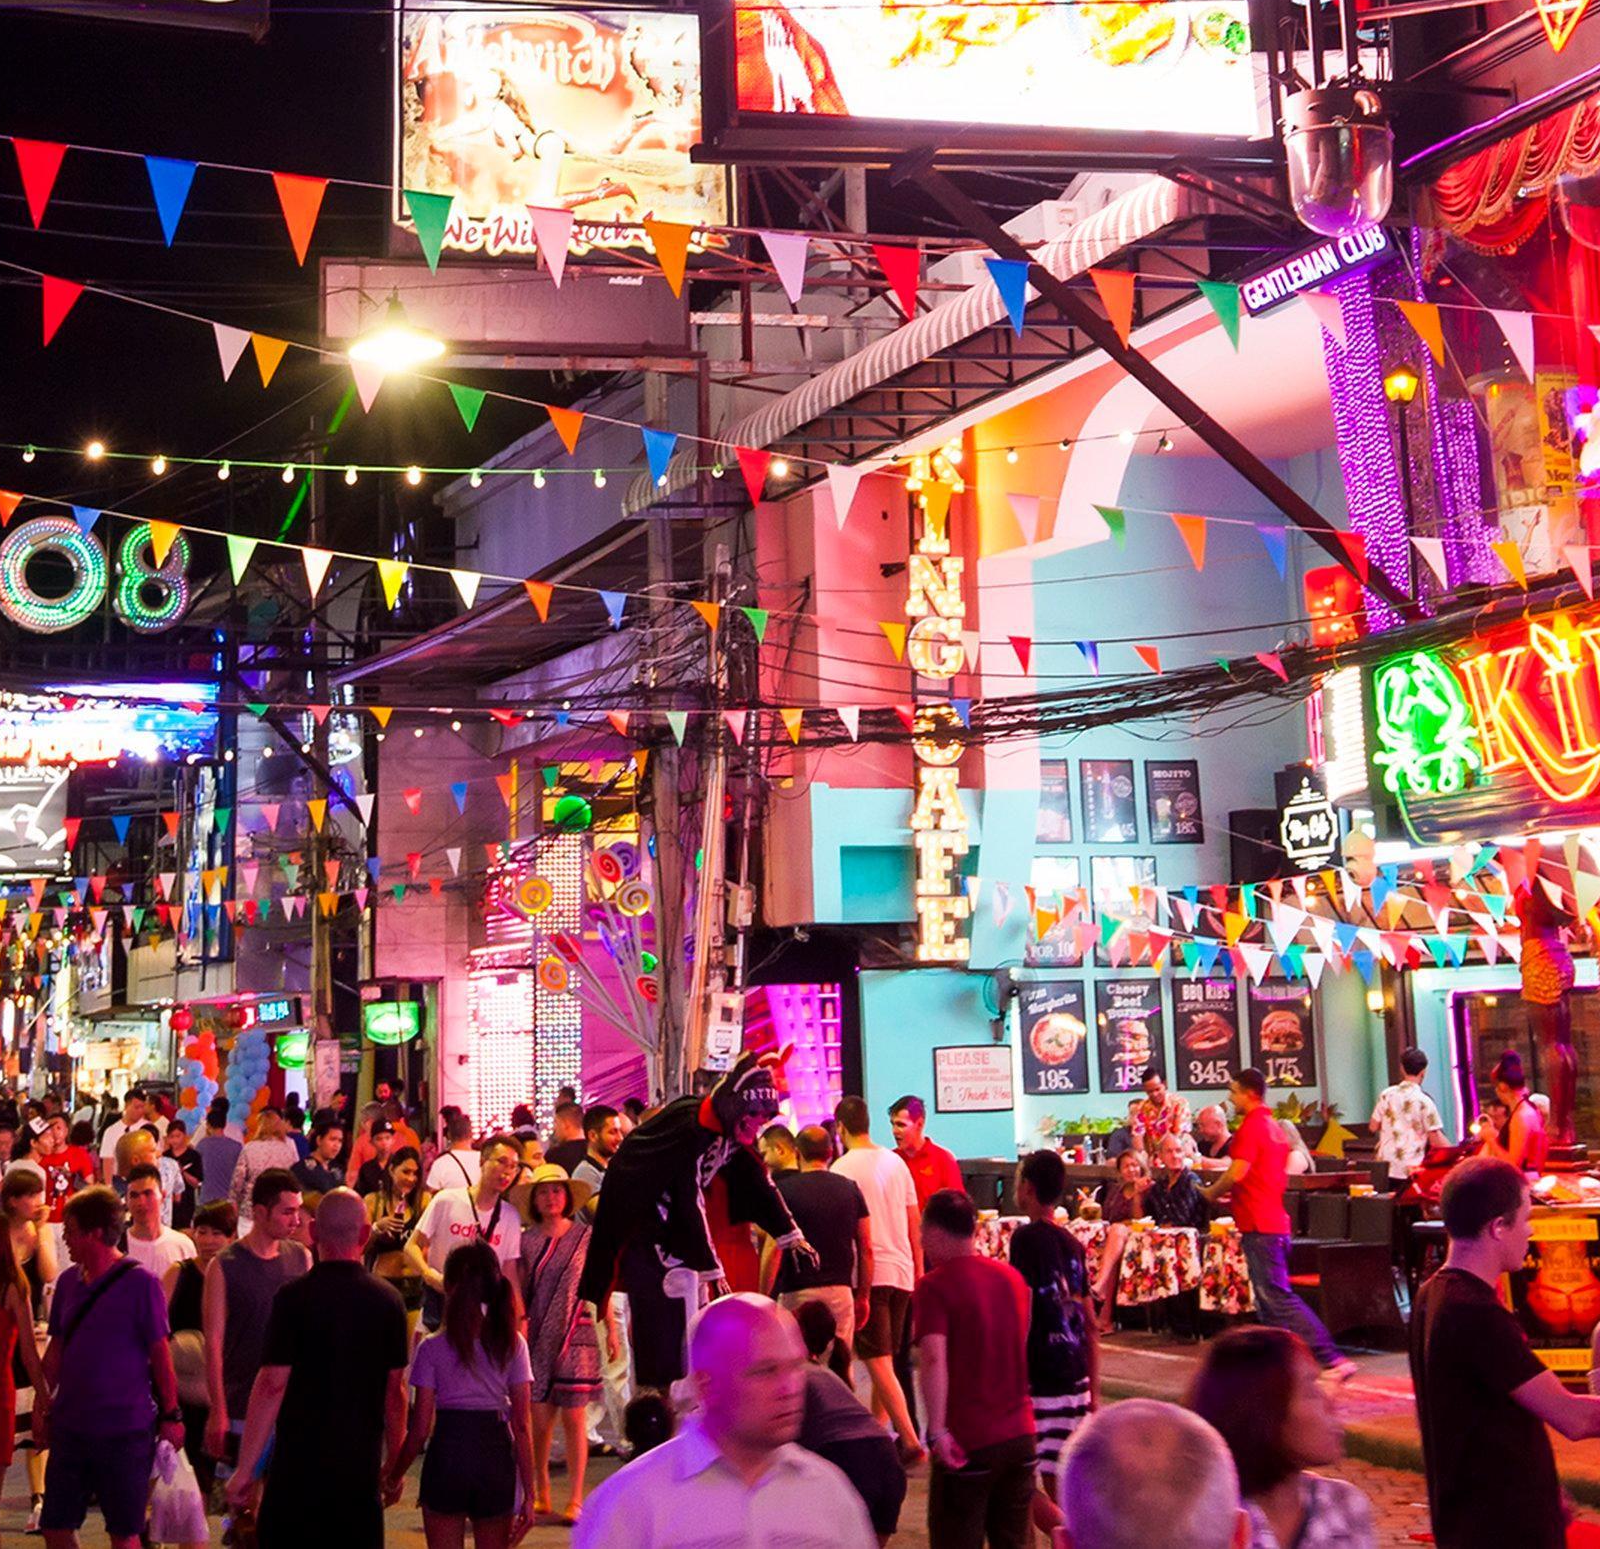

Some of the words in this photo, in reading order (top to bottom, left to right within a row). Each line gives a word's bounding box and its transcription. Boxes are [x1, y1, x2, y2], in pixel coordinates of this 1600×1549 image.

[1243, 243, 1342, 310] GENTLEMAN
[1338, 224, 1387, 265] CLUB
[905, 434, 967, 682] KING
[1152, 769, 1192, 780] MOJITO
[1106, 983, 1150, 999] Cheesy
[1182, 983, 1204, 1000] BBQ
[1113, 995, 1143, 1009] Beef
[936, 1052, 991, 1066] PLEASE
[1188, 1059, 1232, 1086] 345.
[1266, 1057, 1304, 1081] 175.
[1037, 1069, 1074, 1091] 195.
